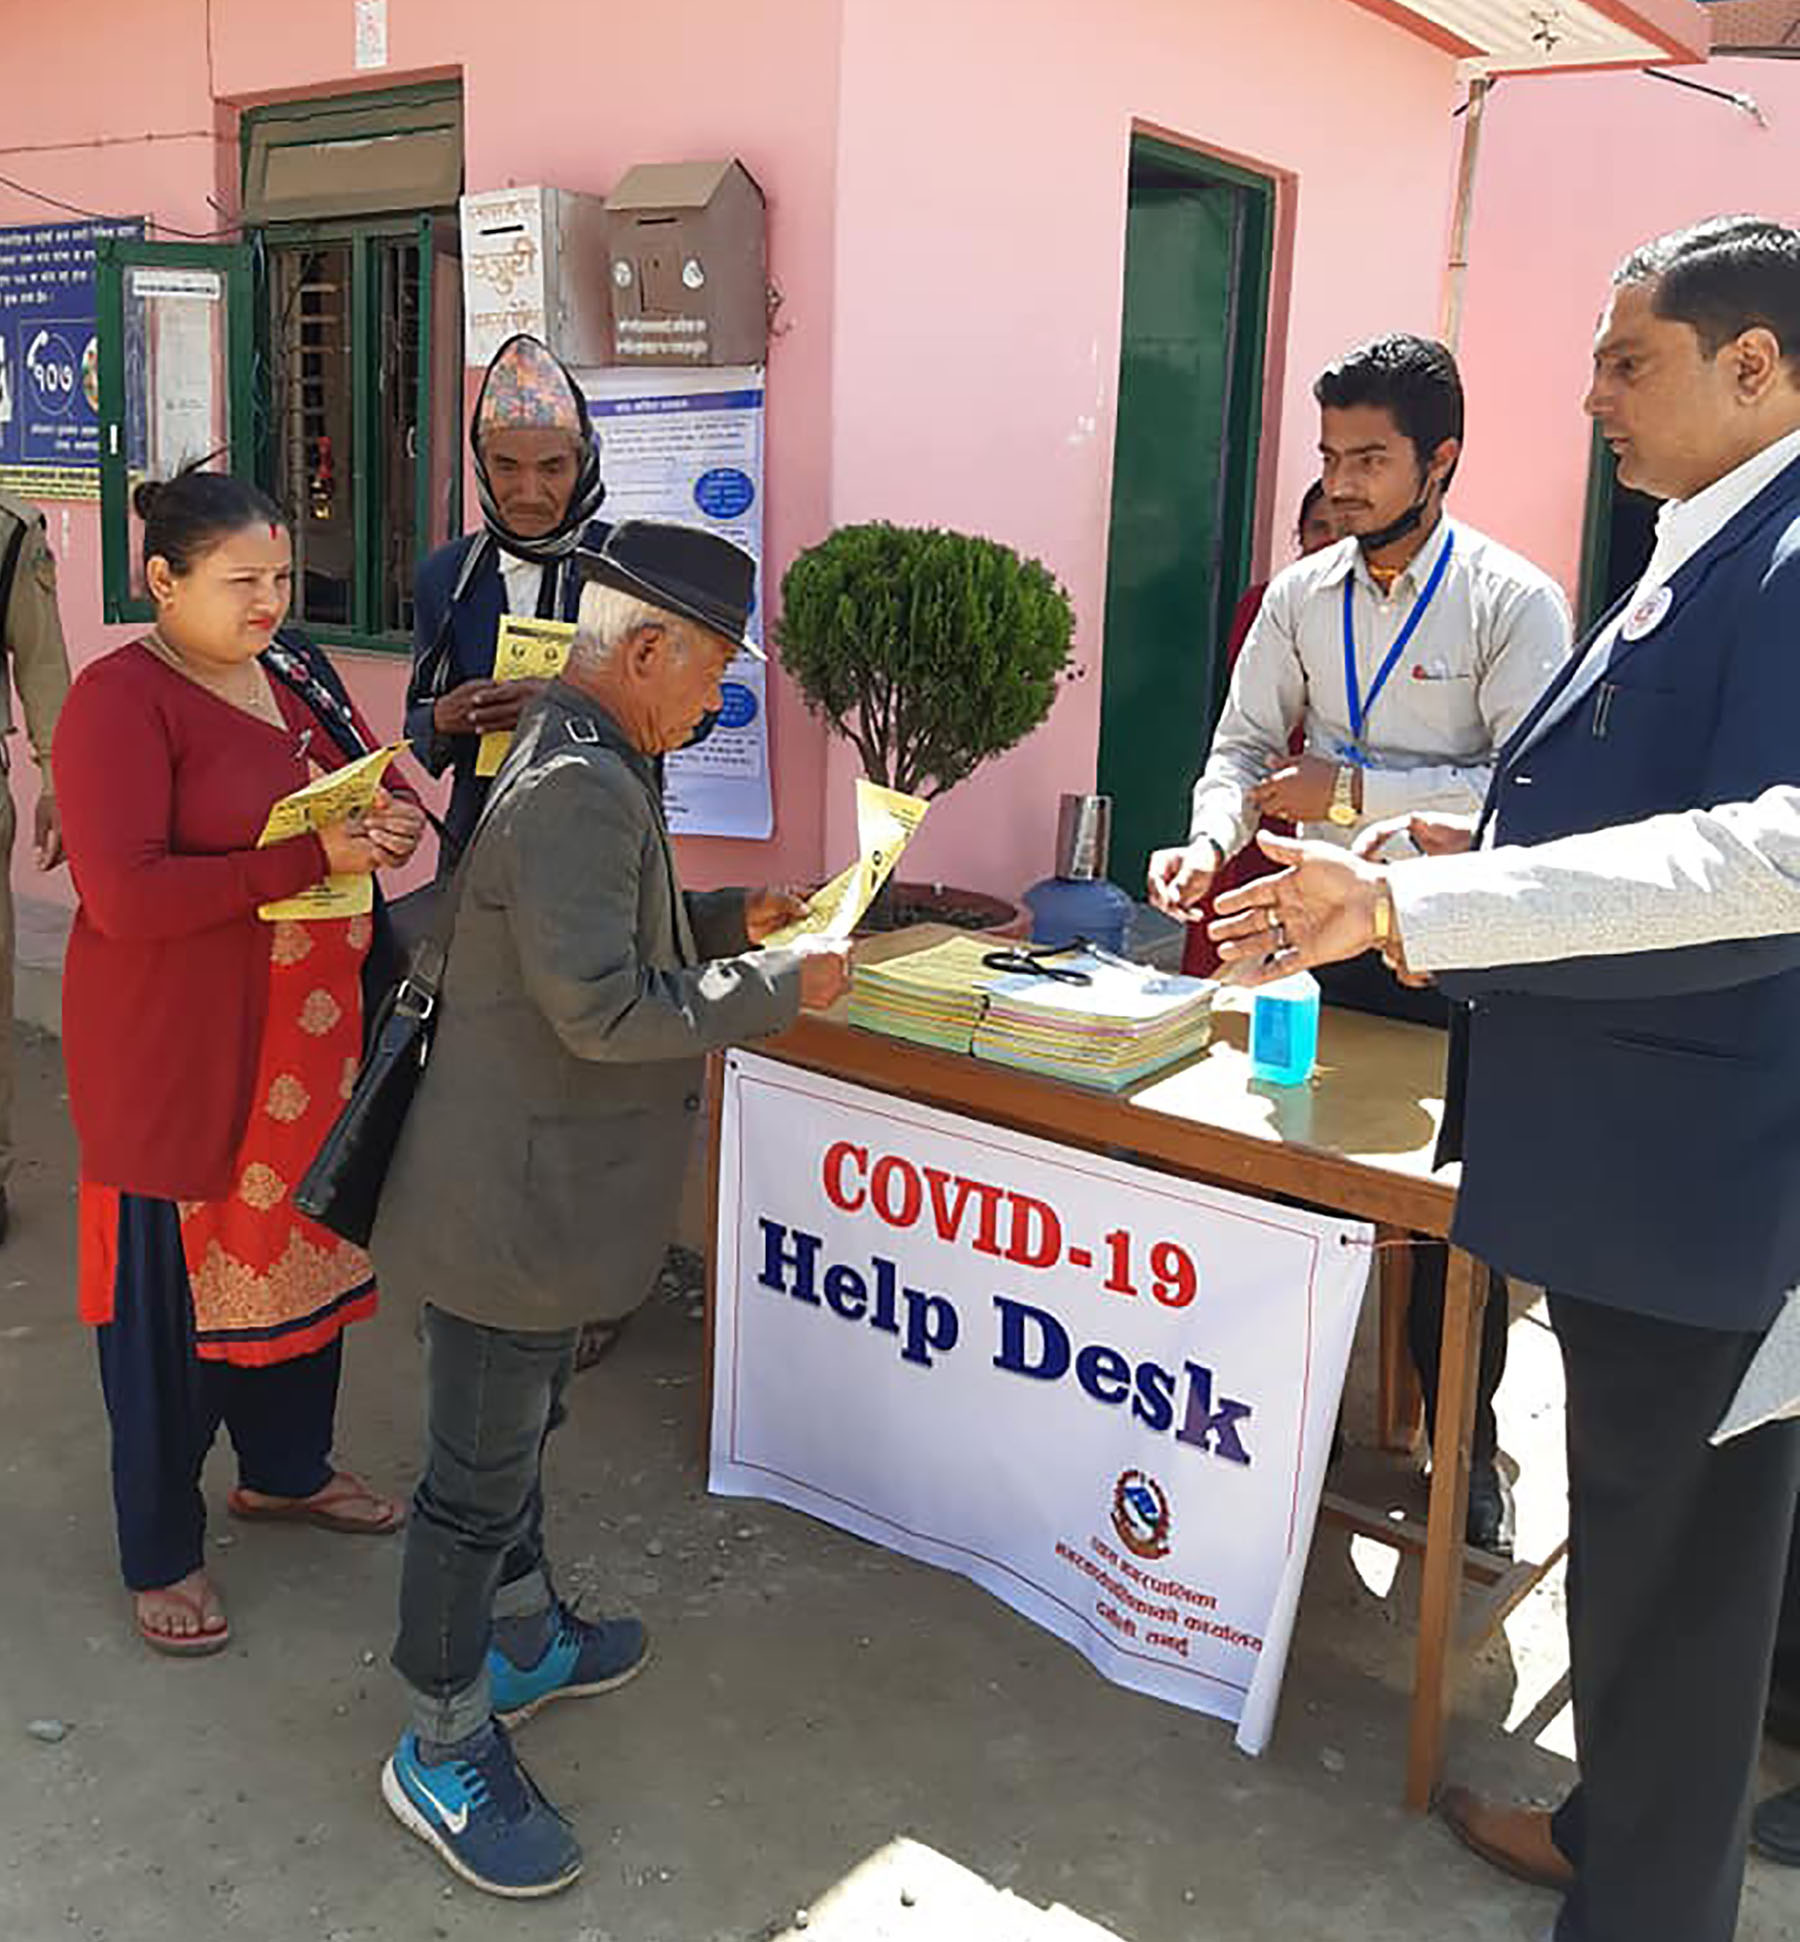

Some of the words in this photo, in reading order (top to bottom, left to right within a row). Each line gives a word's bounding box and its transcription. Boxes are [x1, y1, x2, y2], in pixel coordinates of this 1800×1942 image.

[822, 1140, 1198, 1308] COVID-19
[757, 1219, 959, 1368] Help
[992, 1295, 1253, 1465] Desk
